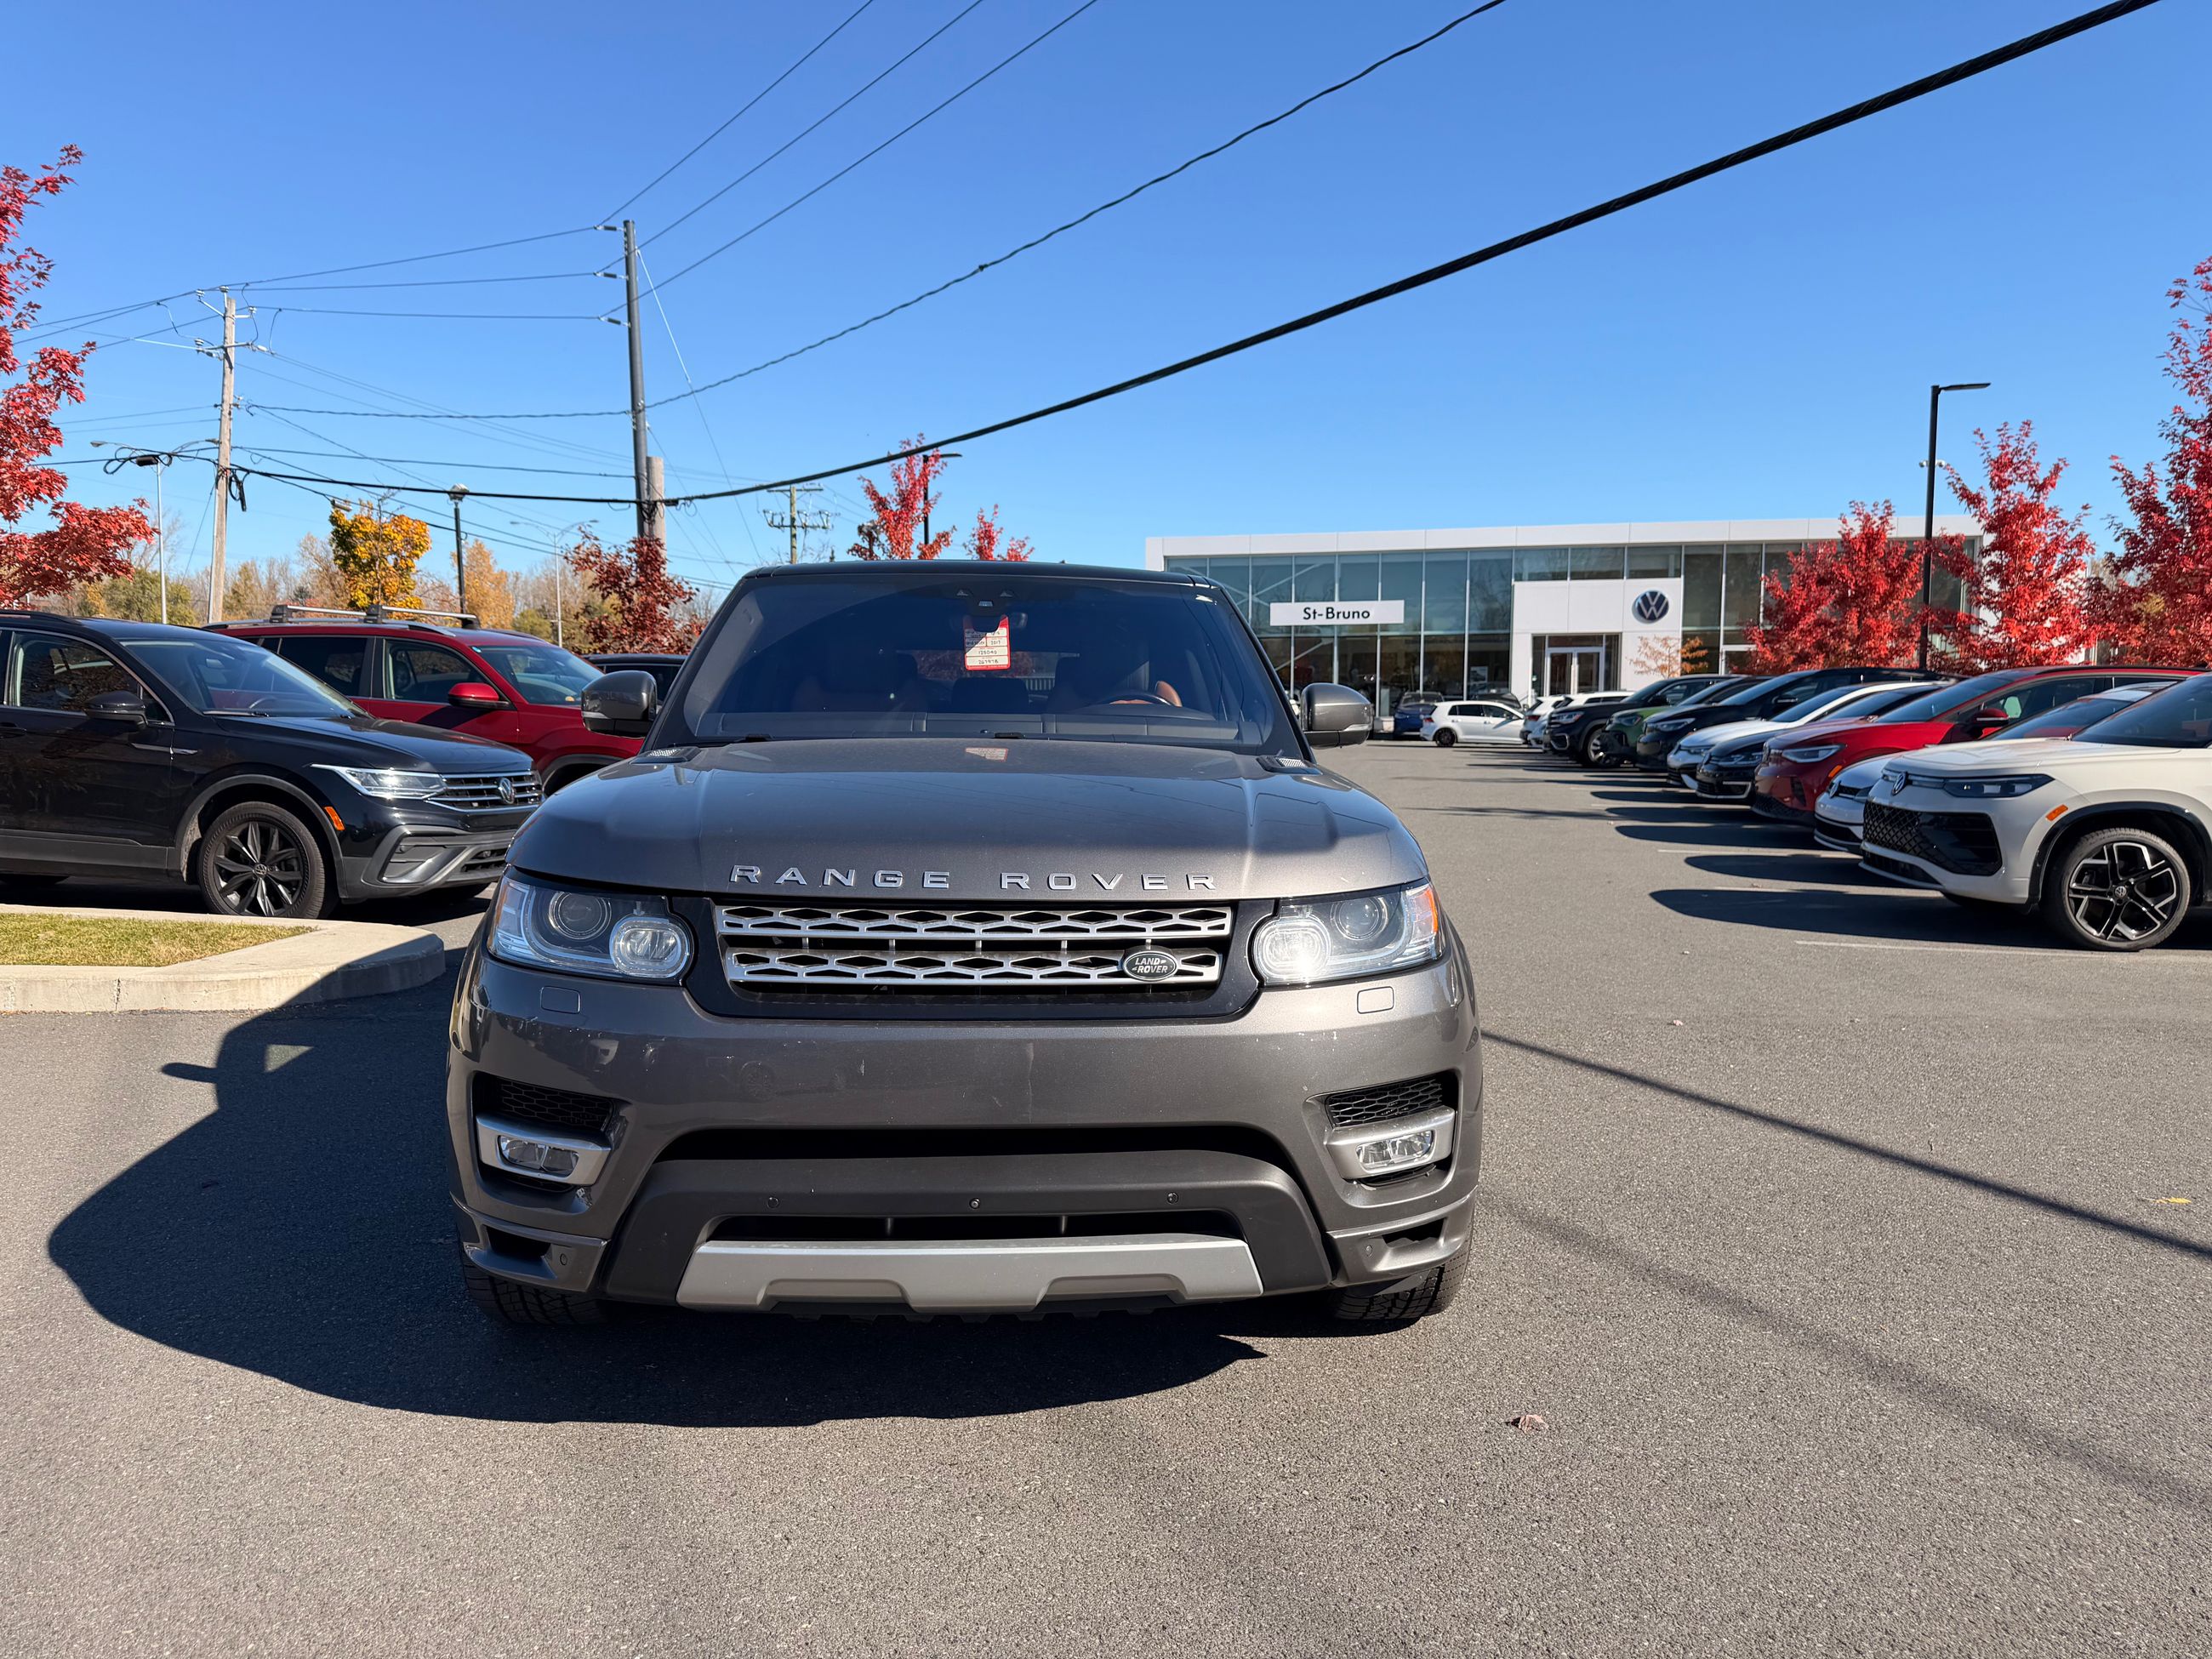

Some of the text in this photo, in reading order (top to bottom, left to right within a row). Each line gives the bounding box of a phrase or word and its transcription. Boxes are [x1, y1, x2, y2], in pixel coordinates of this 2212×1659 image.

[1303, 607, 1371, 620] St-Bruno
[730, 864, 1217, 890] RANGE ROVER
[1135, 957, 1160, 966] LAND
[1137, 965, 1168, 973] ROVER
